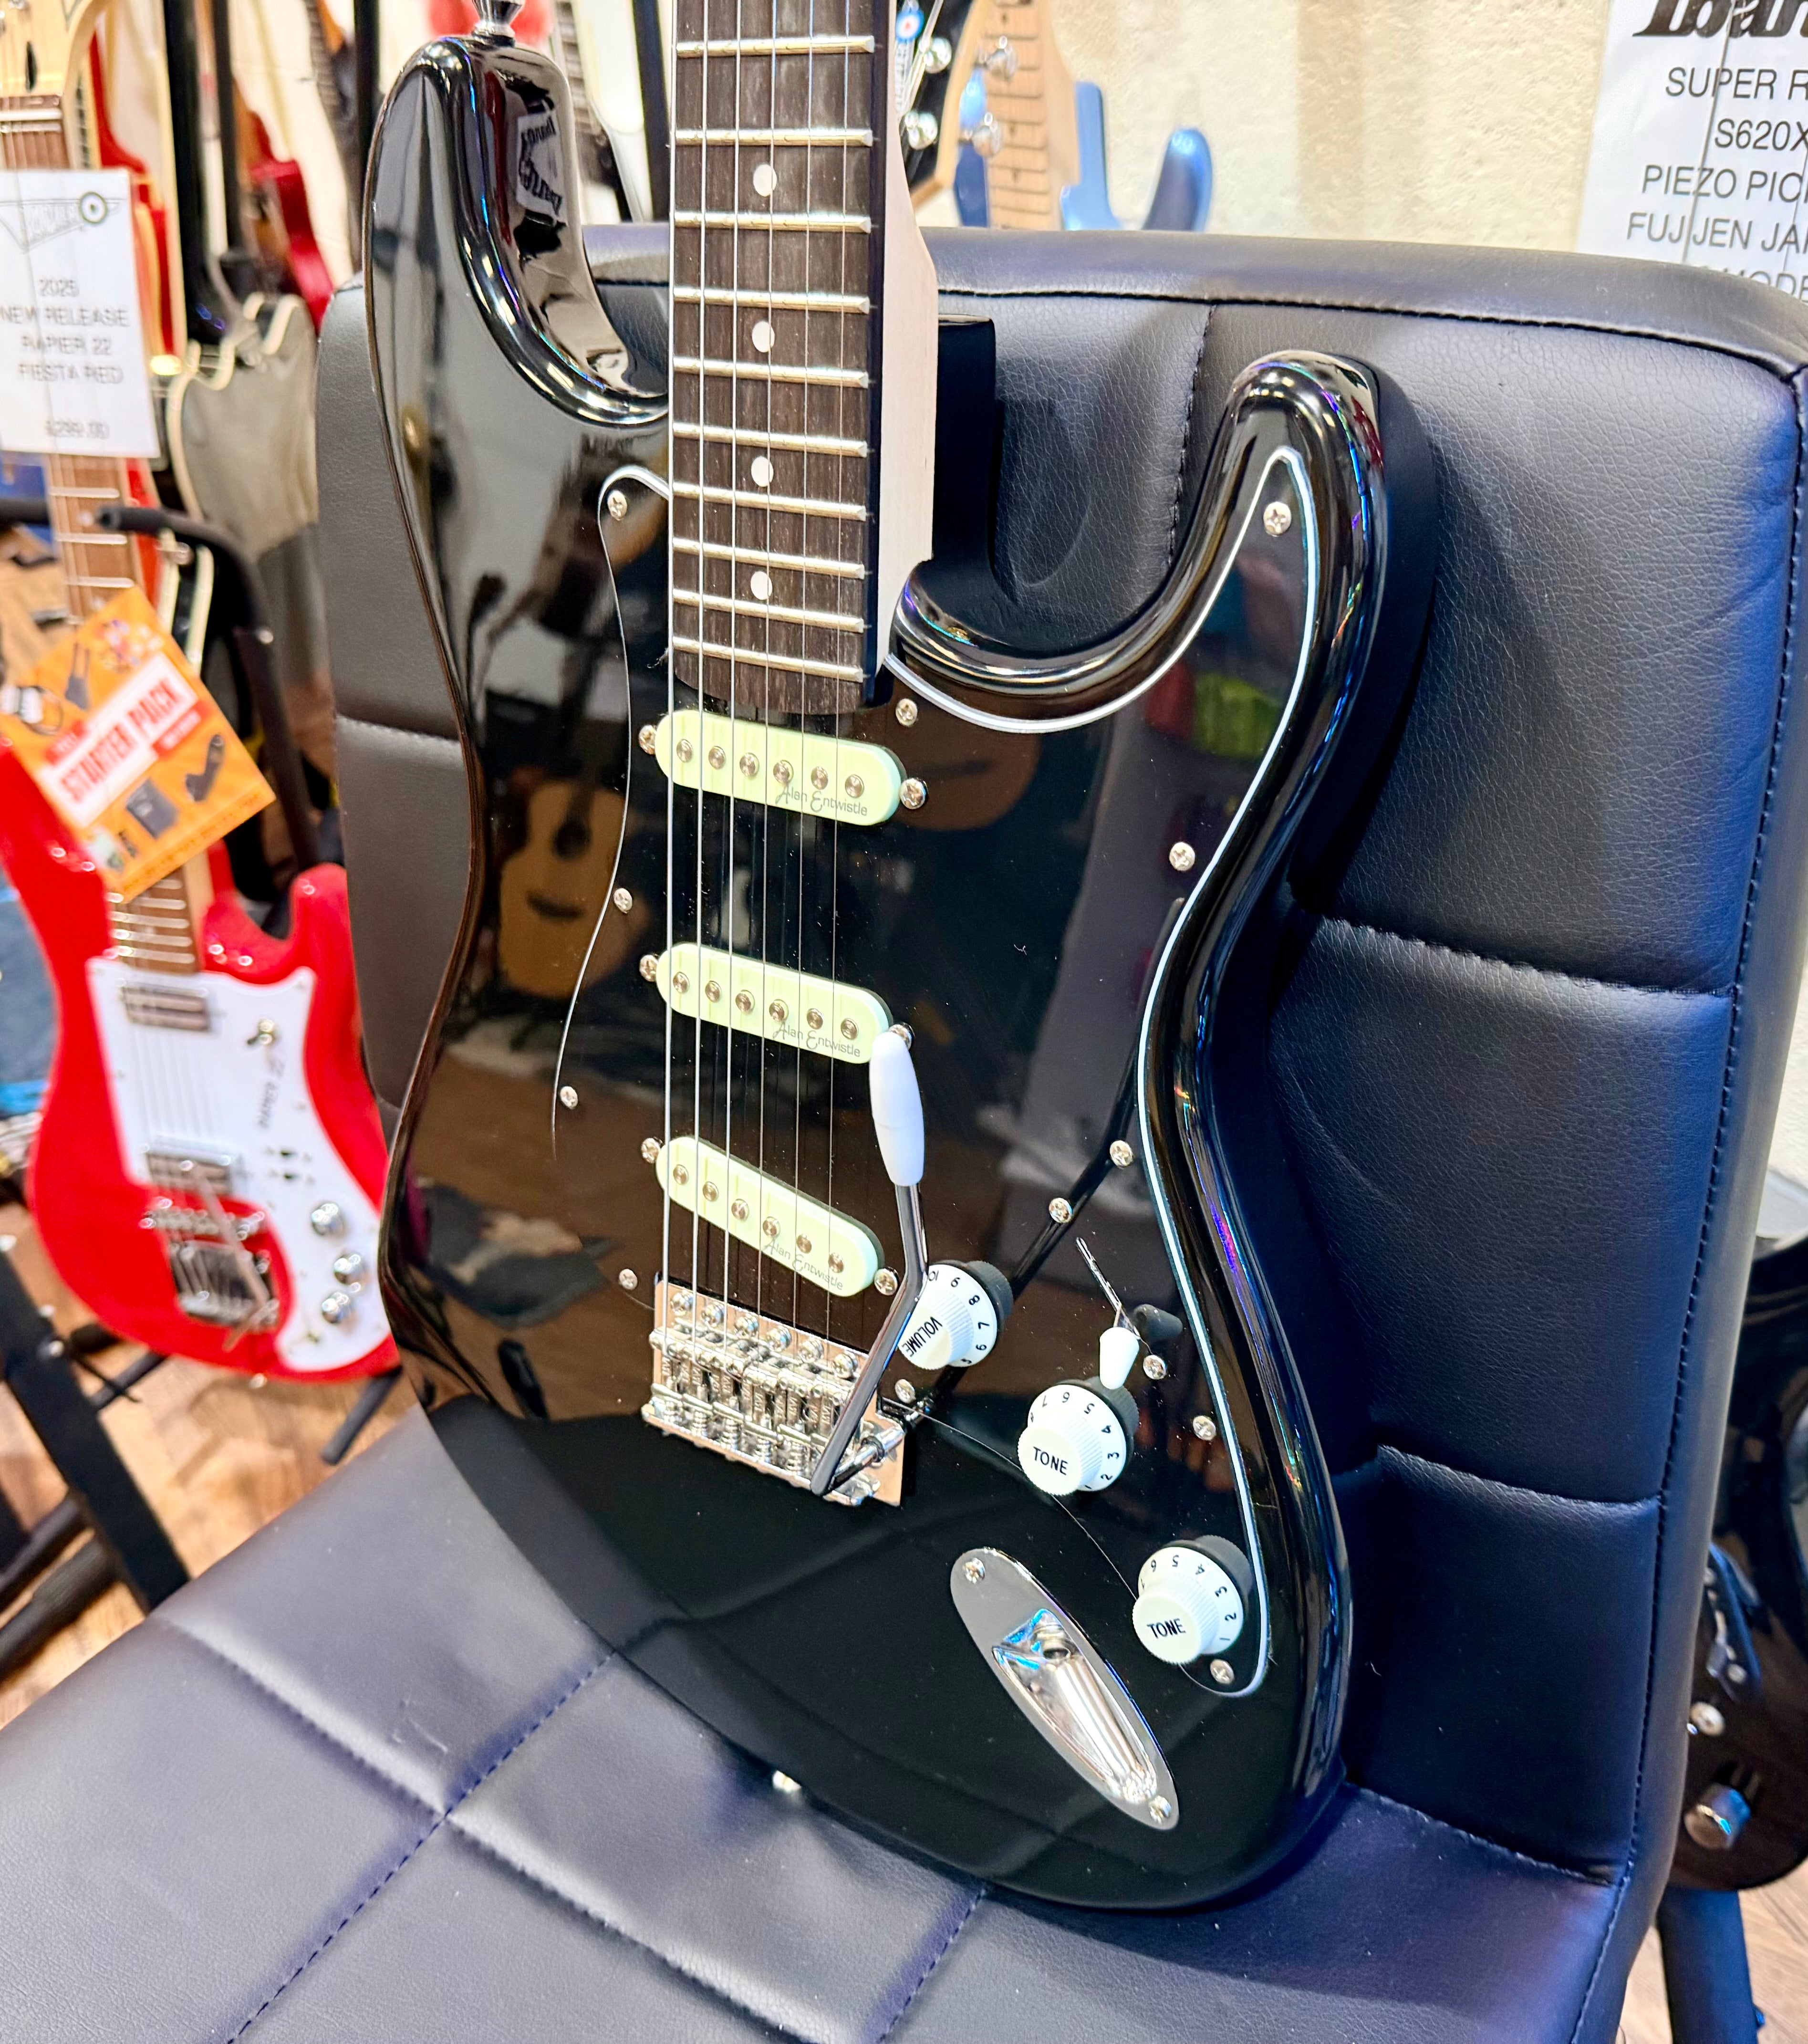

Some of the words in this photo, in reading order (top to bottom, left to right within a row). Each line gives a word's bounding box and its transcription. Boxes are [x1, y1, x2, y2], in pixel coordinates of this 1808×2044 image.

[1666, 67, 1777, 99] SUPER
[1715, 118, 1808, 151] S620X
[1642, 165, 1737, 198] PIEZO
[1746, 170, 1808, 203] PIC
[39, 278, 80, 298] 2025
[0, 306, 38, 325] NEW
[44, 306, 130, 327] RELEASE
[128, 678, 185, 742] PACK
[775, 783, 807, 804] Alan
[810, 791, 868, 816] Entwistle
[773, 1019, 804, 1040] Alan
[806, 1031, 861, 1058] Entwistle
[763, 1237, 791, 1260] Alan
[792, 1253, 843, 1291] Entwistle
[968, 1295, 980, 1305] 8
[902, 1316, 943, 1357] VOLUME
[1084, 1403, 1095, 1414] 5
[1101, 1425, 1112, 1434] 4
[1033, 1446, 1069, 1476] TONE
[1172, 1554, 1179, 1567] 5
[1195, 1564, 1205, 1575] 4
[1215, 1586, 1227, 1597] 3
[1225, 1612, 1237, 1622] 2
[1147, 1618, 1186, 1639] TONE
